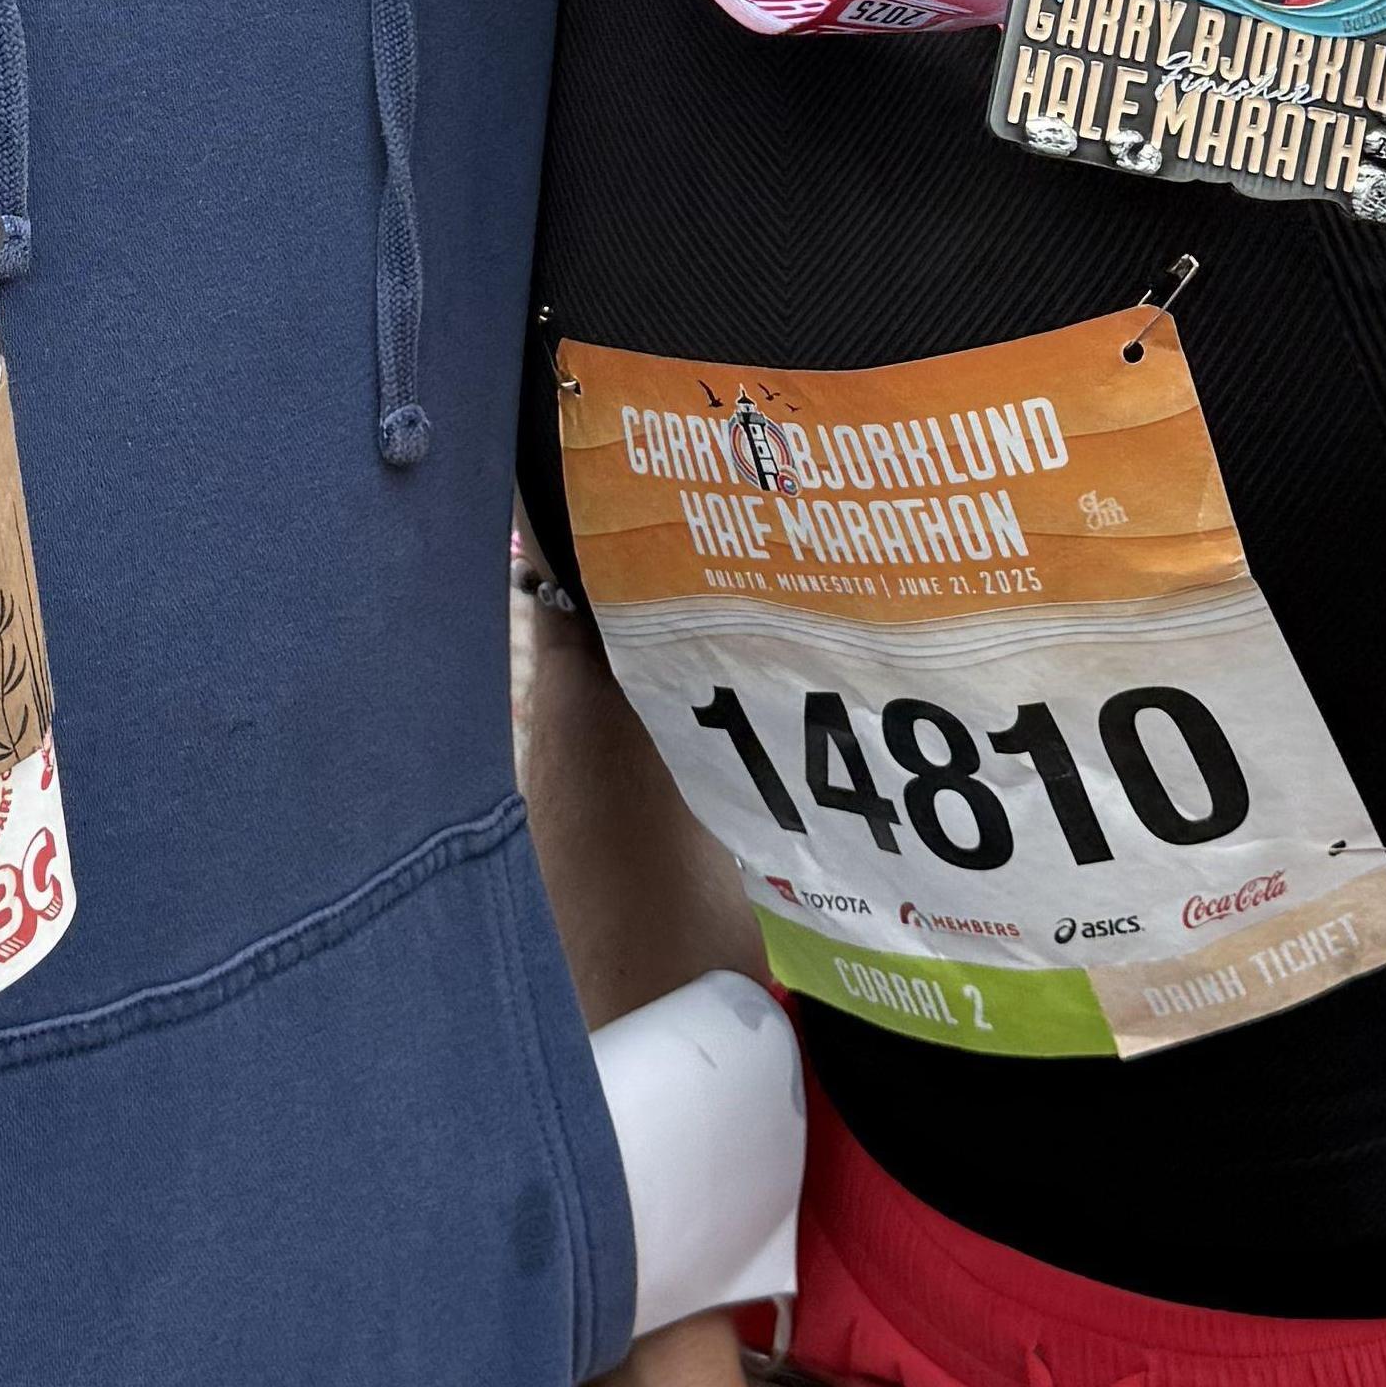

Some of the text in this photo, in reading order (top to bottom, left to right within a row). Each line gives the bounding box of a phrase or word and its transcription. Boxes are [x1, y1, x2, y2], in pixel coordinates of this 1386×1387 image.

[848, 0, 923, 27] 2025
[1007, 45, 1150, 143] HALF
[1155, 51, 1321, 105] Finisher
[620, 396, 1070, 490] GARRY BJORKLUND
[679, 489, 1030, 566] HALF MARATHON
[776, 573, 876, 597] MINNESOTA
[898, 575, 944, 597] JUNE
[983, 566, 1043, 596] 2025
[690, 684, 1250, 871] 14810
[800, 890, 873, 916] TOYOTA
[930, 913, 1022, 939] MEMBERS
[1081, 915, 1143, 939] asics
[833, 911, 1362, 1032] CORRAL 2 DRINK TICKET
